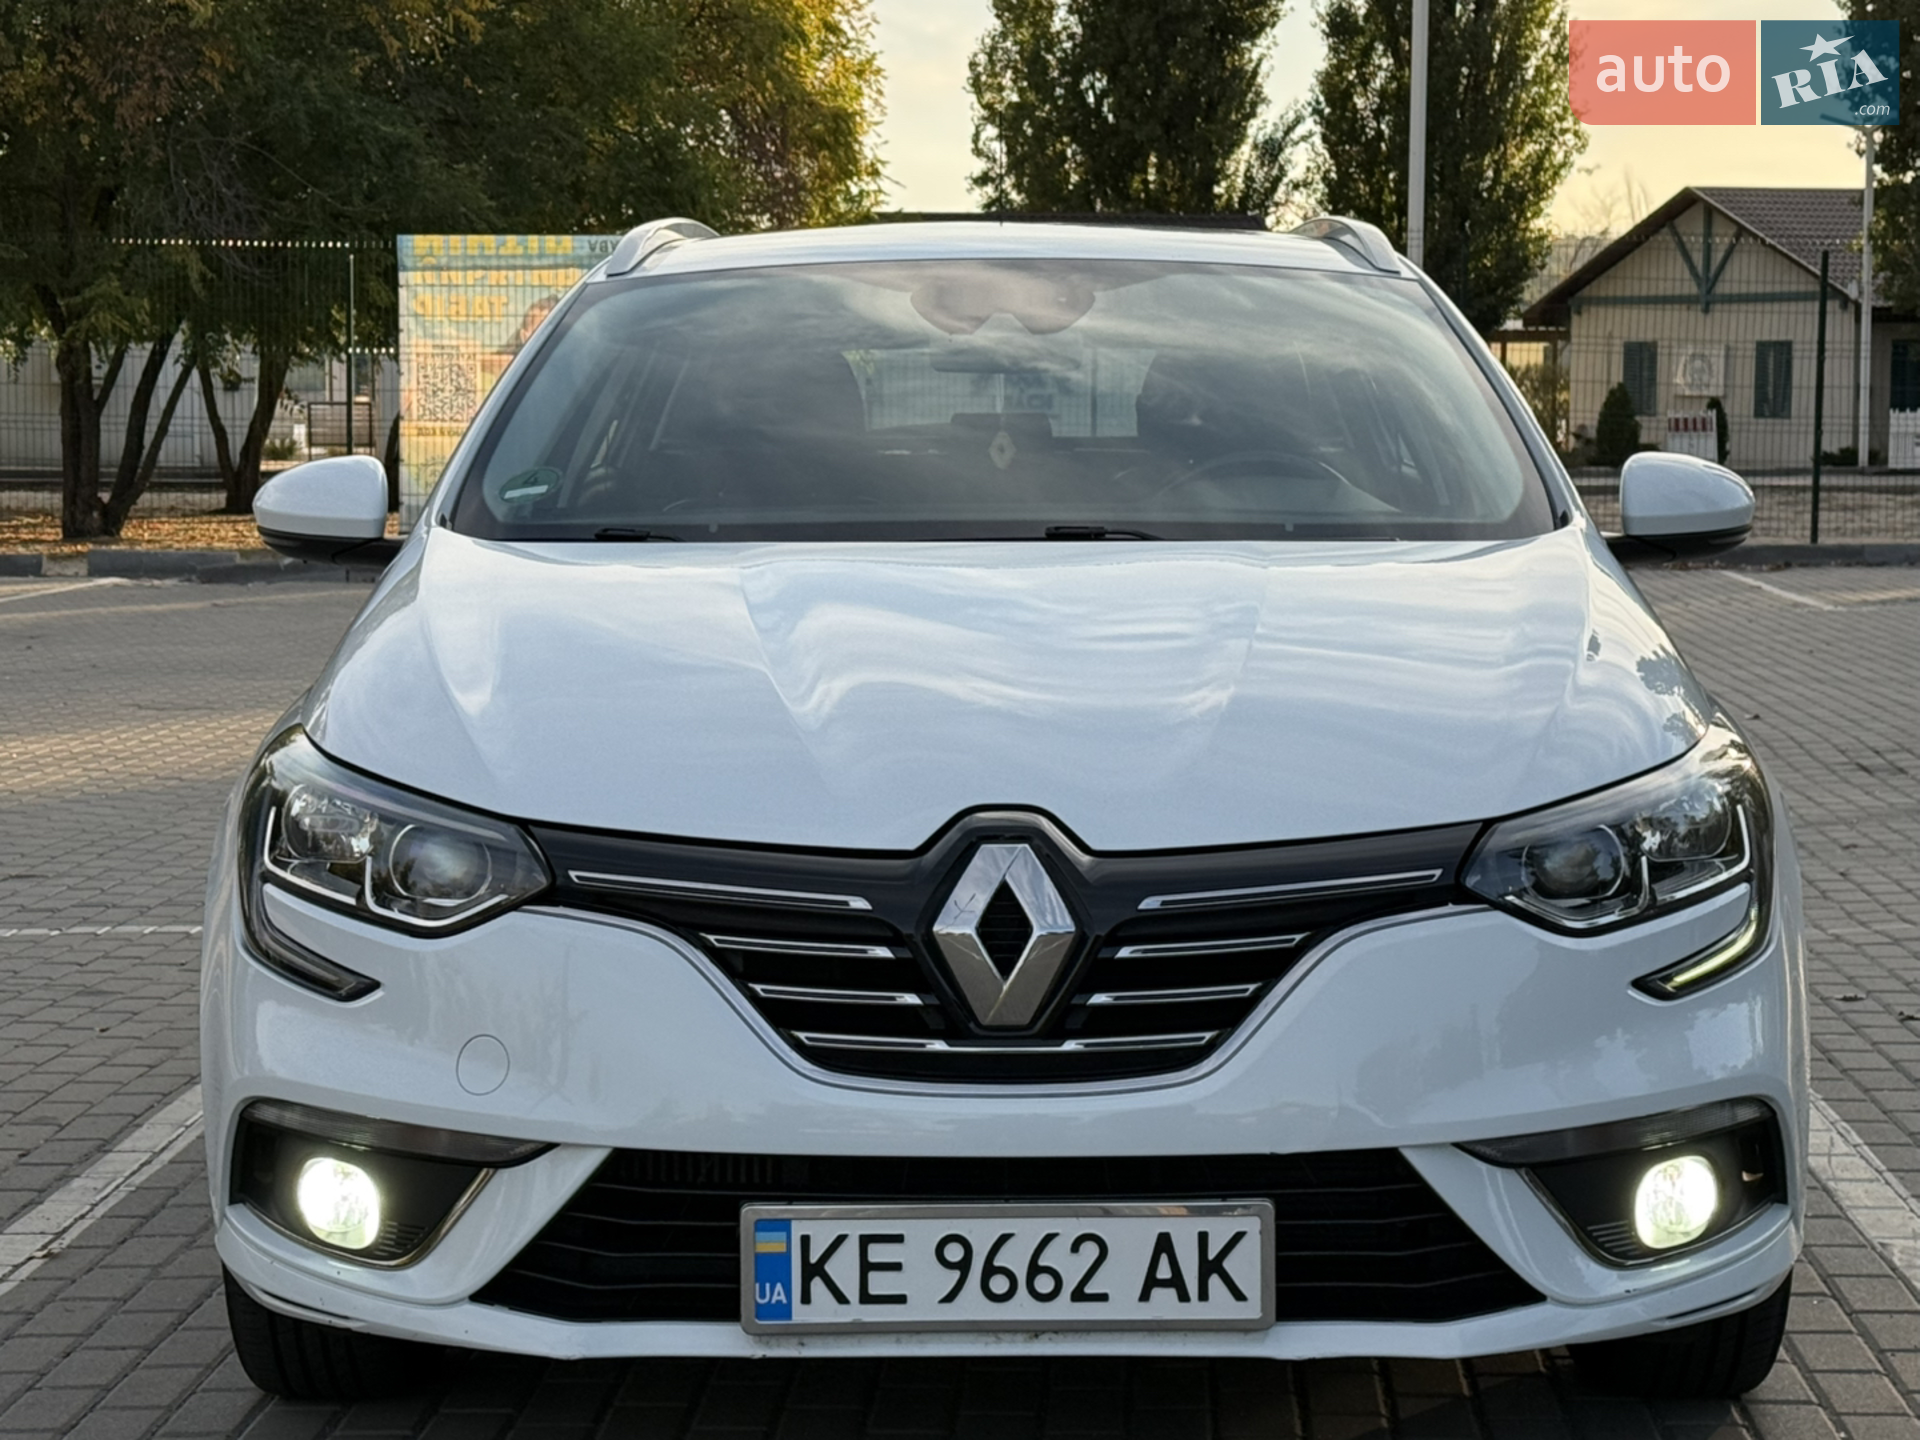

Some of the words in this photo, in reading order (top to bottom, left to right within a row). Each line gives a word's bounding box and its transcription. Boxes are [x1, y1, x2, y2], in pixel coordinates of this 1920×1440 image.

[799, 1233, 908, 1306] KE
[935, 1233, 1110, 1304] 9662
[1138, 1231, 1249, 1303] AK
[755, 1282, 788, 1305] UA
